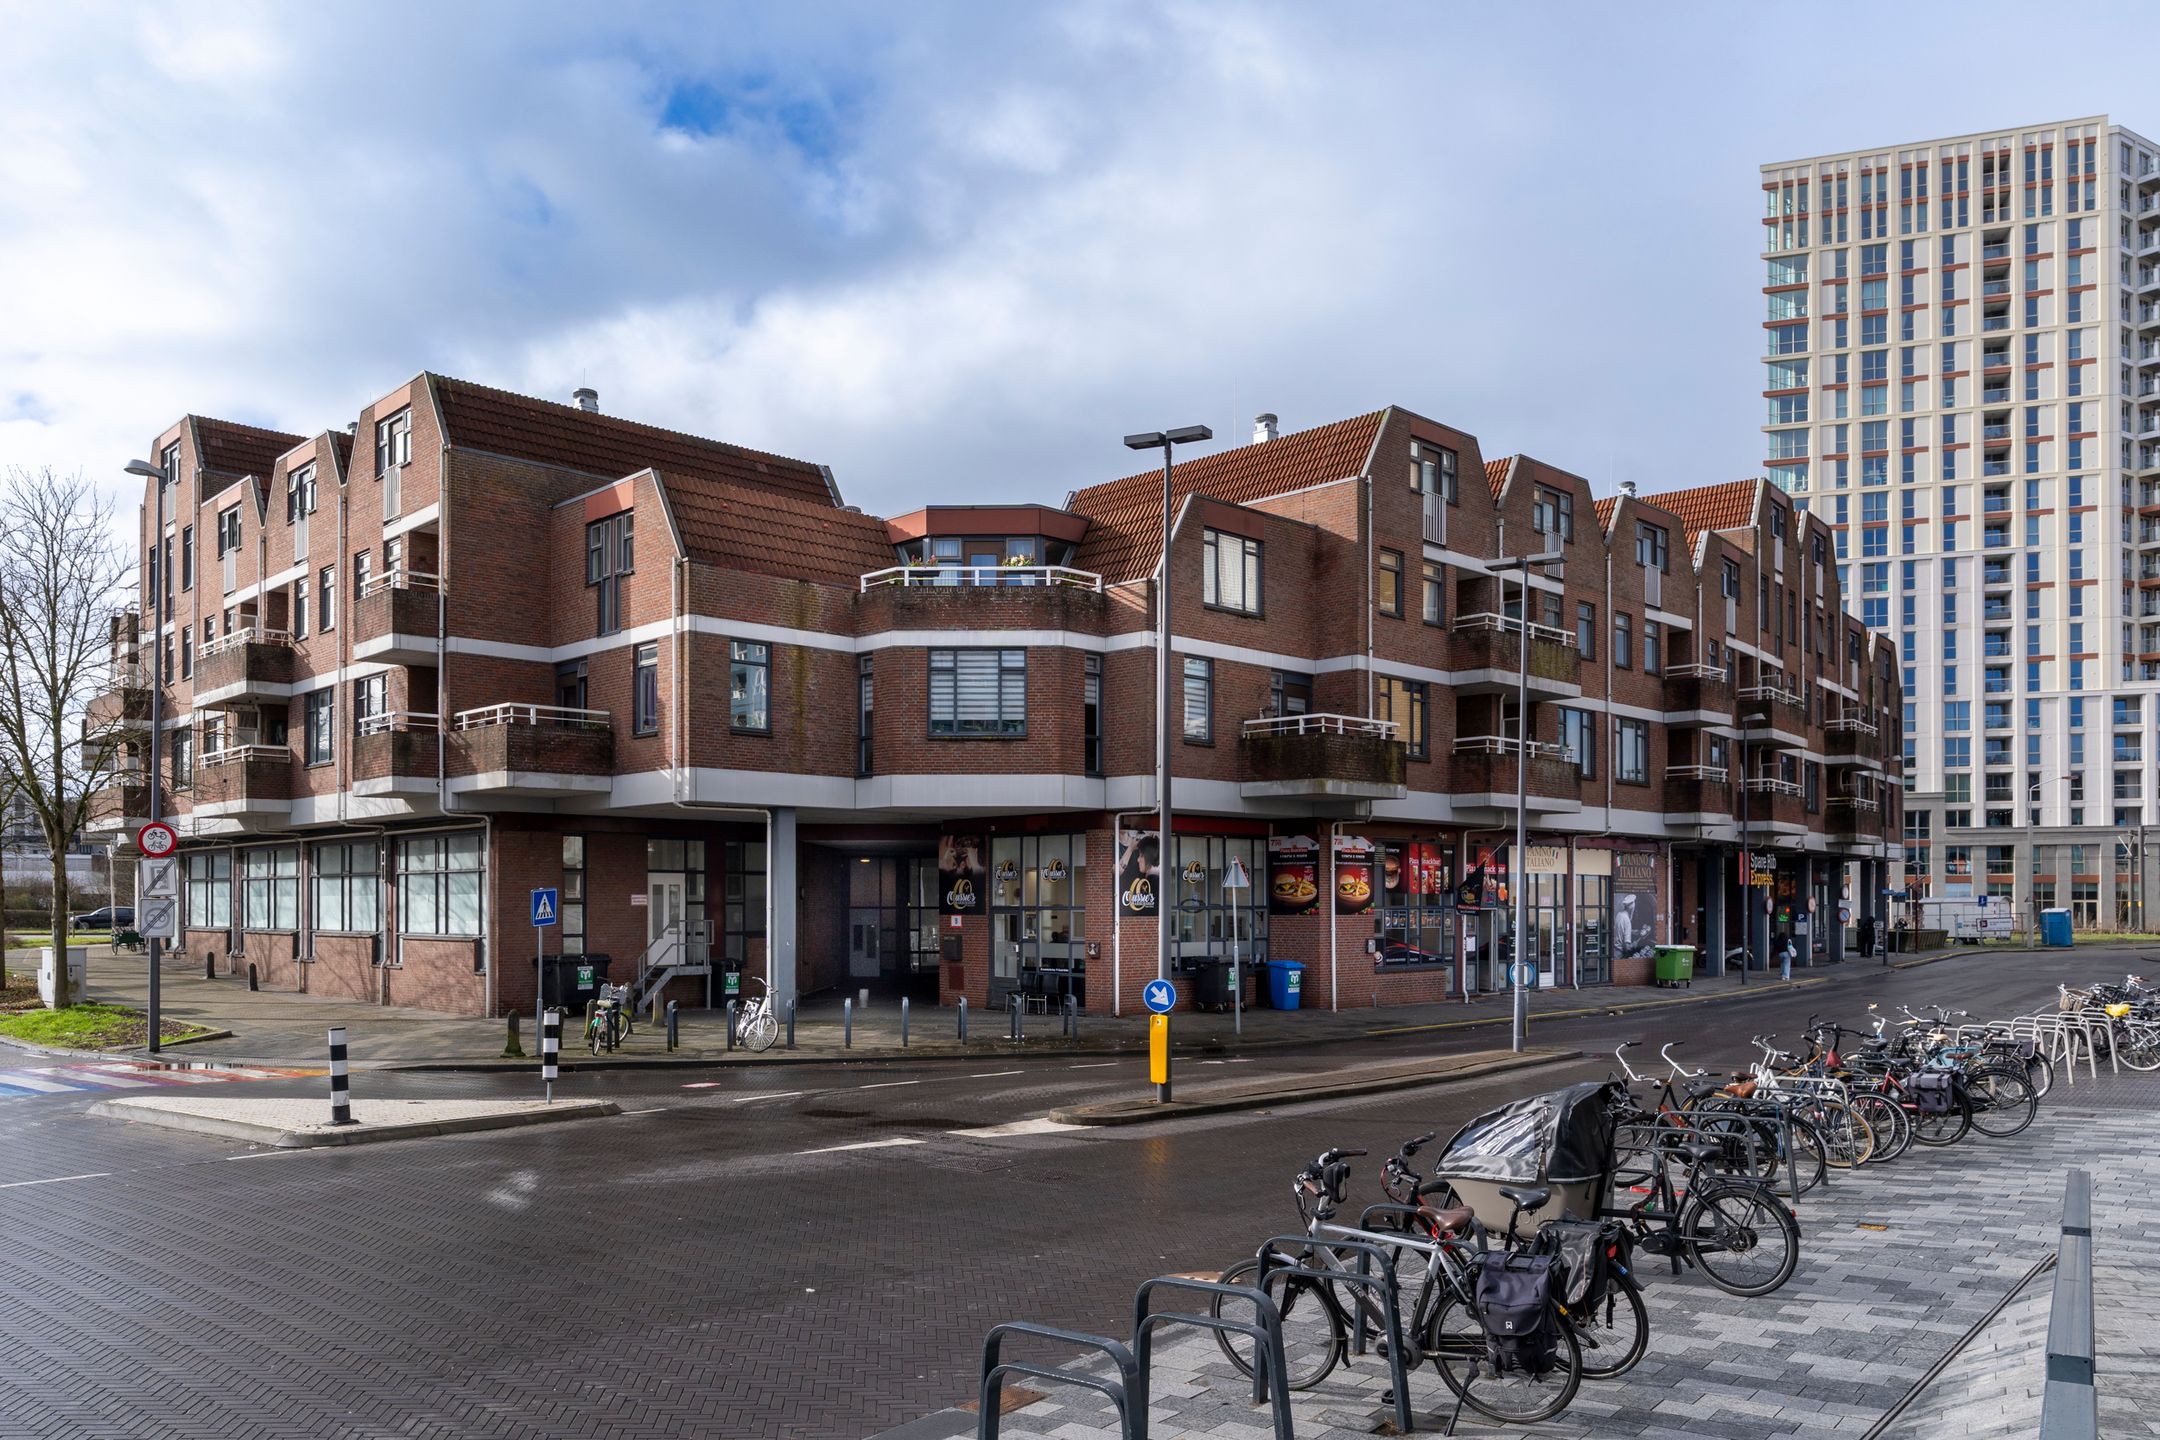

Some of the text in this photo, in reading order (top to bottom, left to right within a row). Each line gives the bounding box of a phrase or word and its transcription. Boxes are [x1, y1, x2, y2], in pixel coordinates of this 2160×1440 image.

[1527, 857, 1555, 867] TALIANO
[1623, 854, 1648, 865] PANINO
[1750, 852, 1777, 872] Spare Rib
[1620, 866, 1652, 878] ITALIANO
[1798, 913, 1805, 921] P
